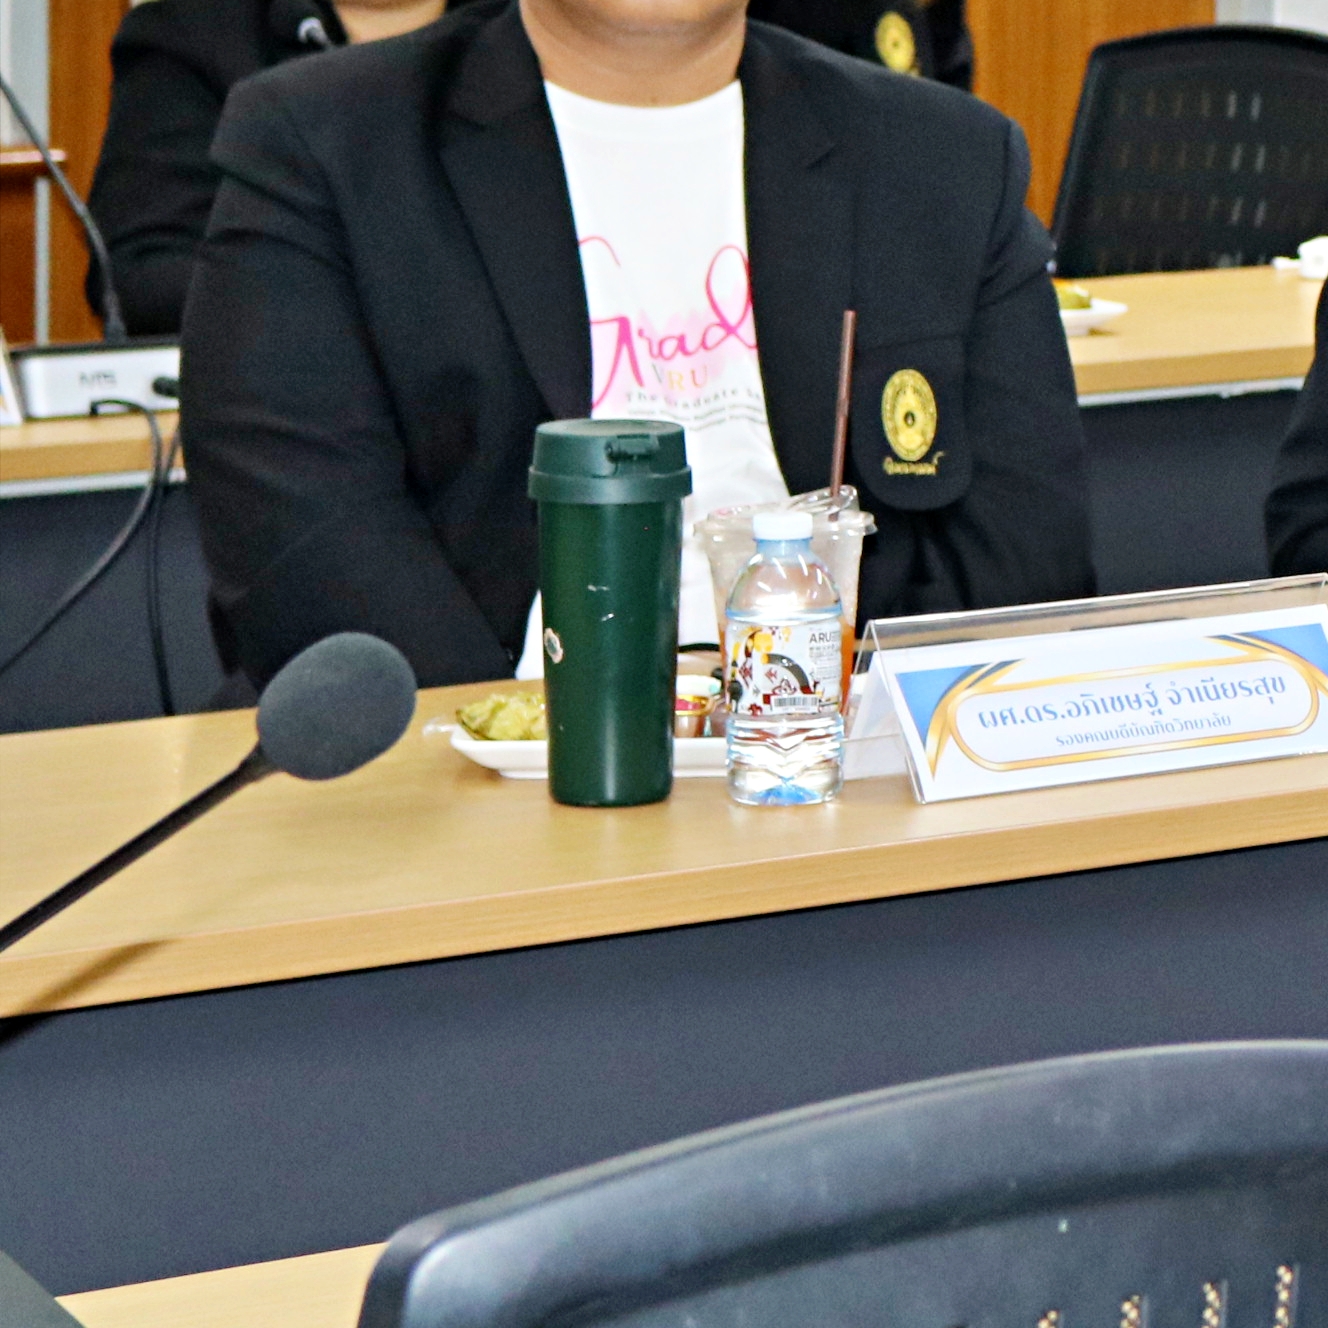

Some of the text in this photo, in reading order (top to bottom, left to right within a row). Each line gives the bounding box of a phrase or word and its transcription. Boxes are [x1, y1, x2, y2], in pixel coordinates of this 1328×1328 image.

[977, 673, 1287, 730] ผศ.ดร.อภิเชษฐ์ จำเนียรสุข
[1055, 713, 1232, 747] รองคณบดีบัณฑิตวิทยาลัย
